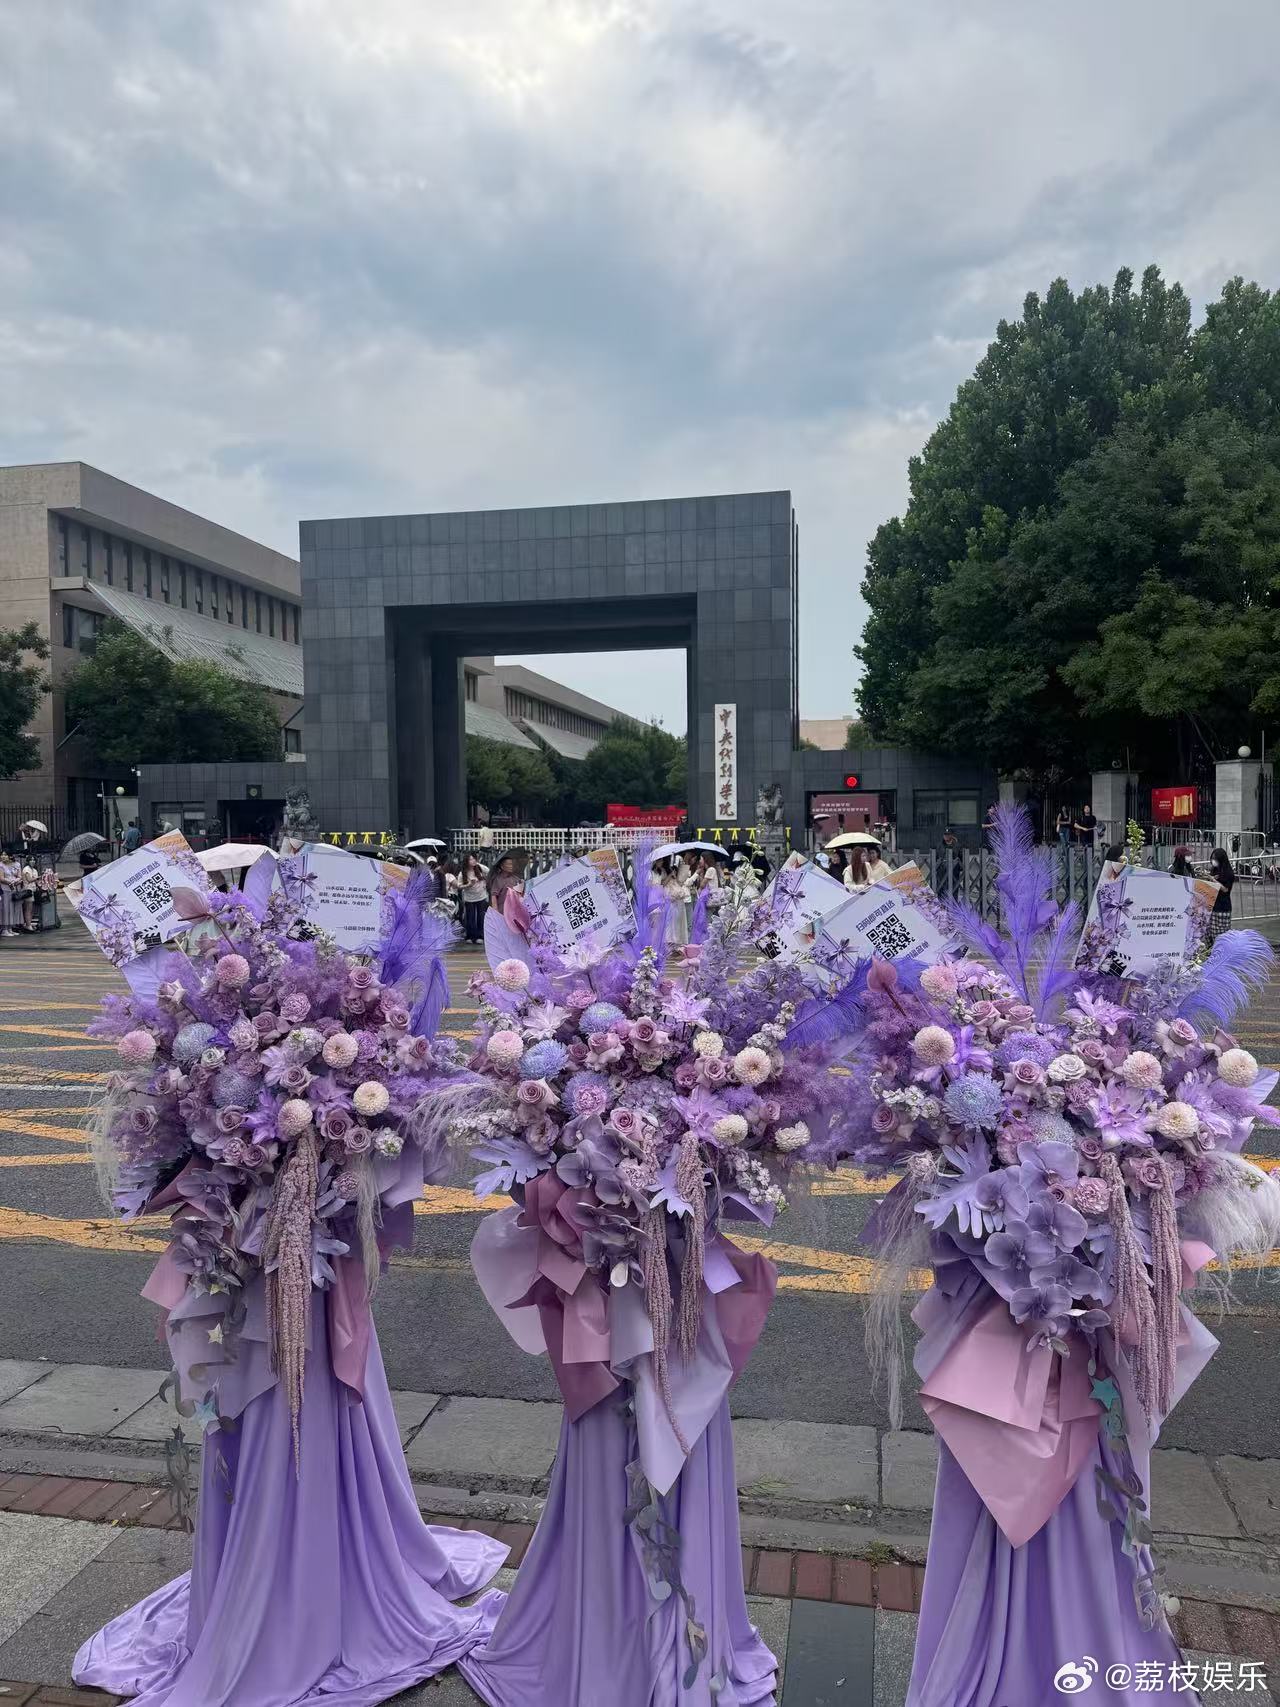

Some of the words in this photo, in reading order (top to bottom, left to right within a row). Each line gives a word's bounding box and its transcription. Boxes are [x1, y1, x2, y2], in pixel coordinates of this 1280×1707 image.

[718, 707, 735, 817] 中央戏剧学院
[856, 900, 896, 932] 扫码即可直达
